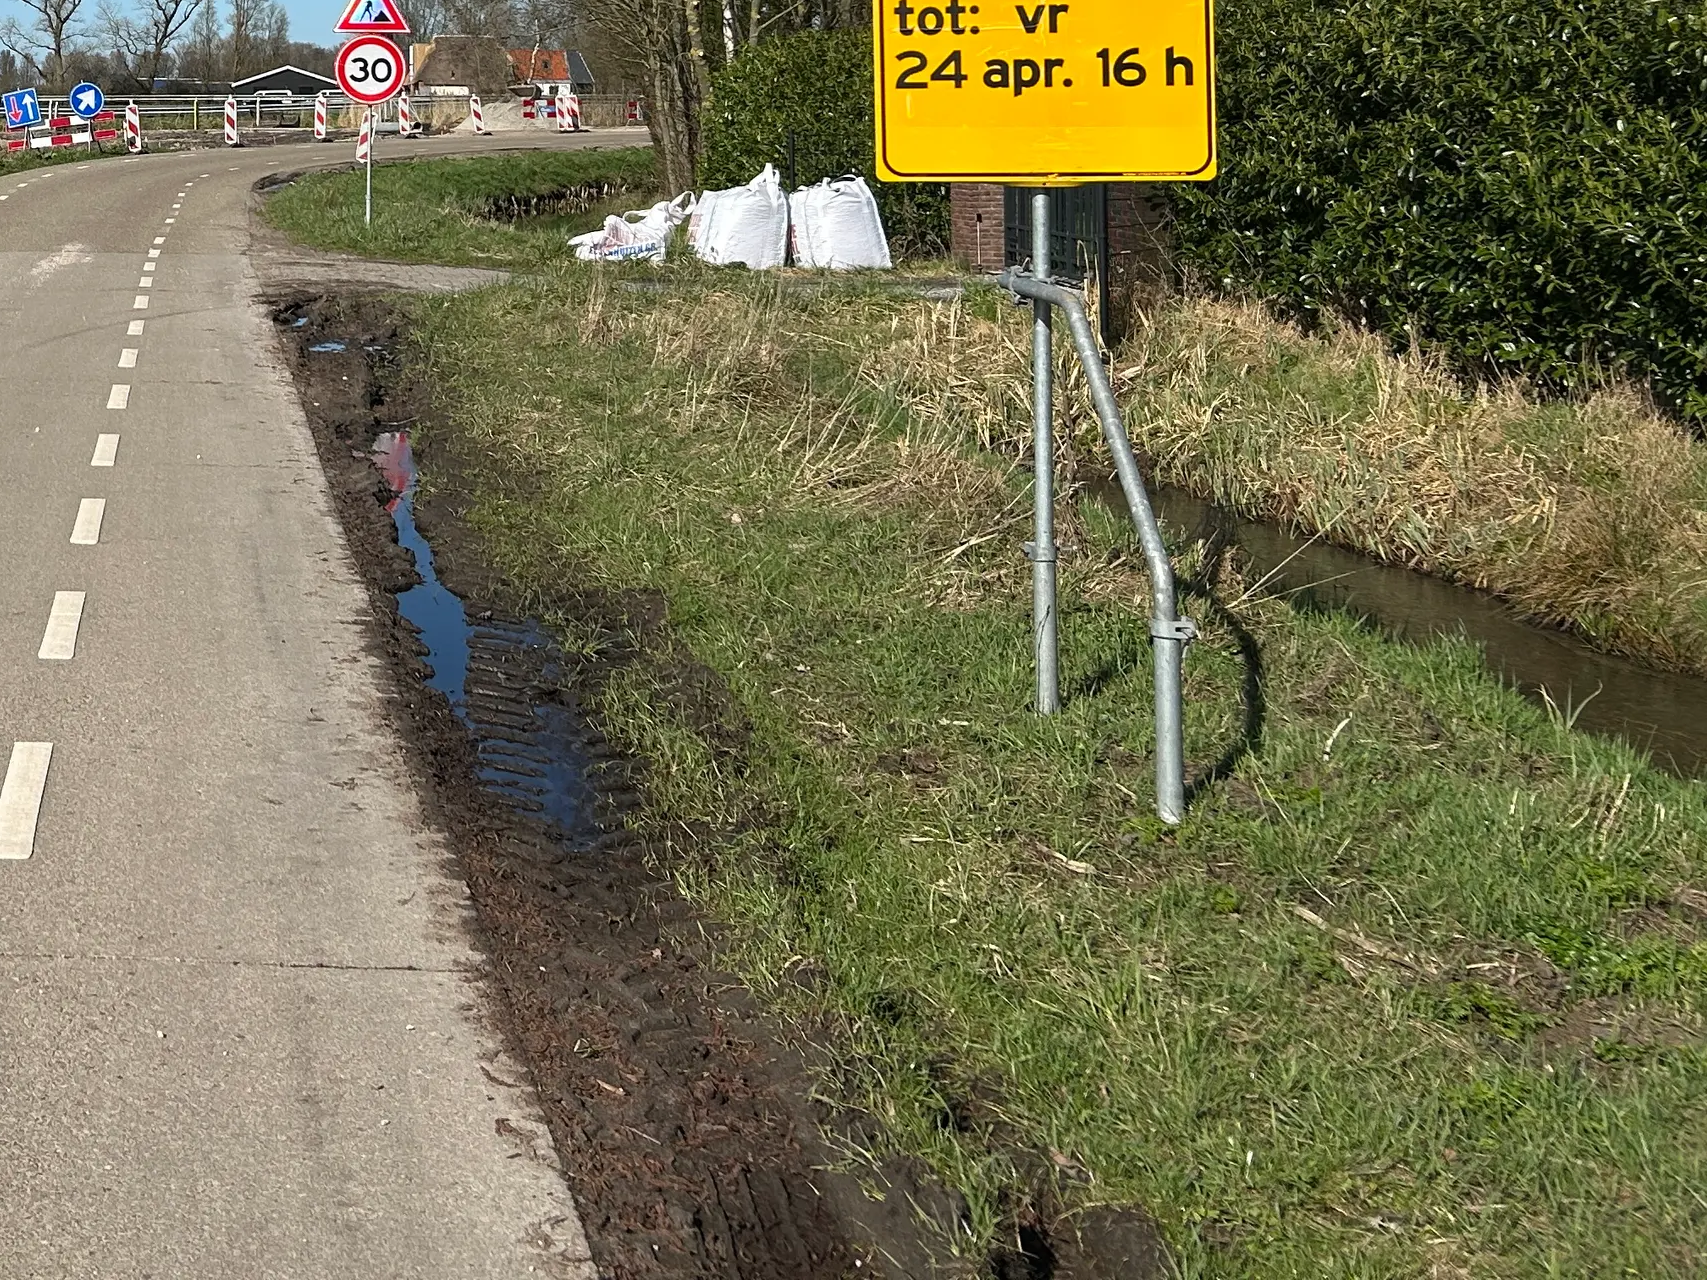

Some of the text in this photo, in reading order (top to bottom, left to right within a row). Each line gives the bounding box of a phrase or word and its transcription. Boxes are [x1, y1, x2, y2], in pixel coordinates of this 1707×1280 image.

[1015, 4, 1069, 34] vr
[349, 57, 392, 83] 30
[895, 47, 1194, 97] 24 apr. 16 h
